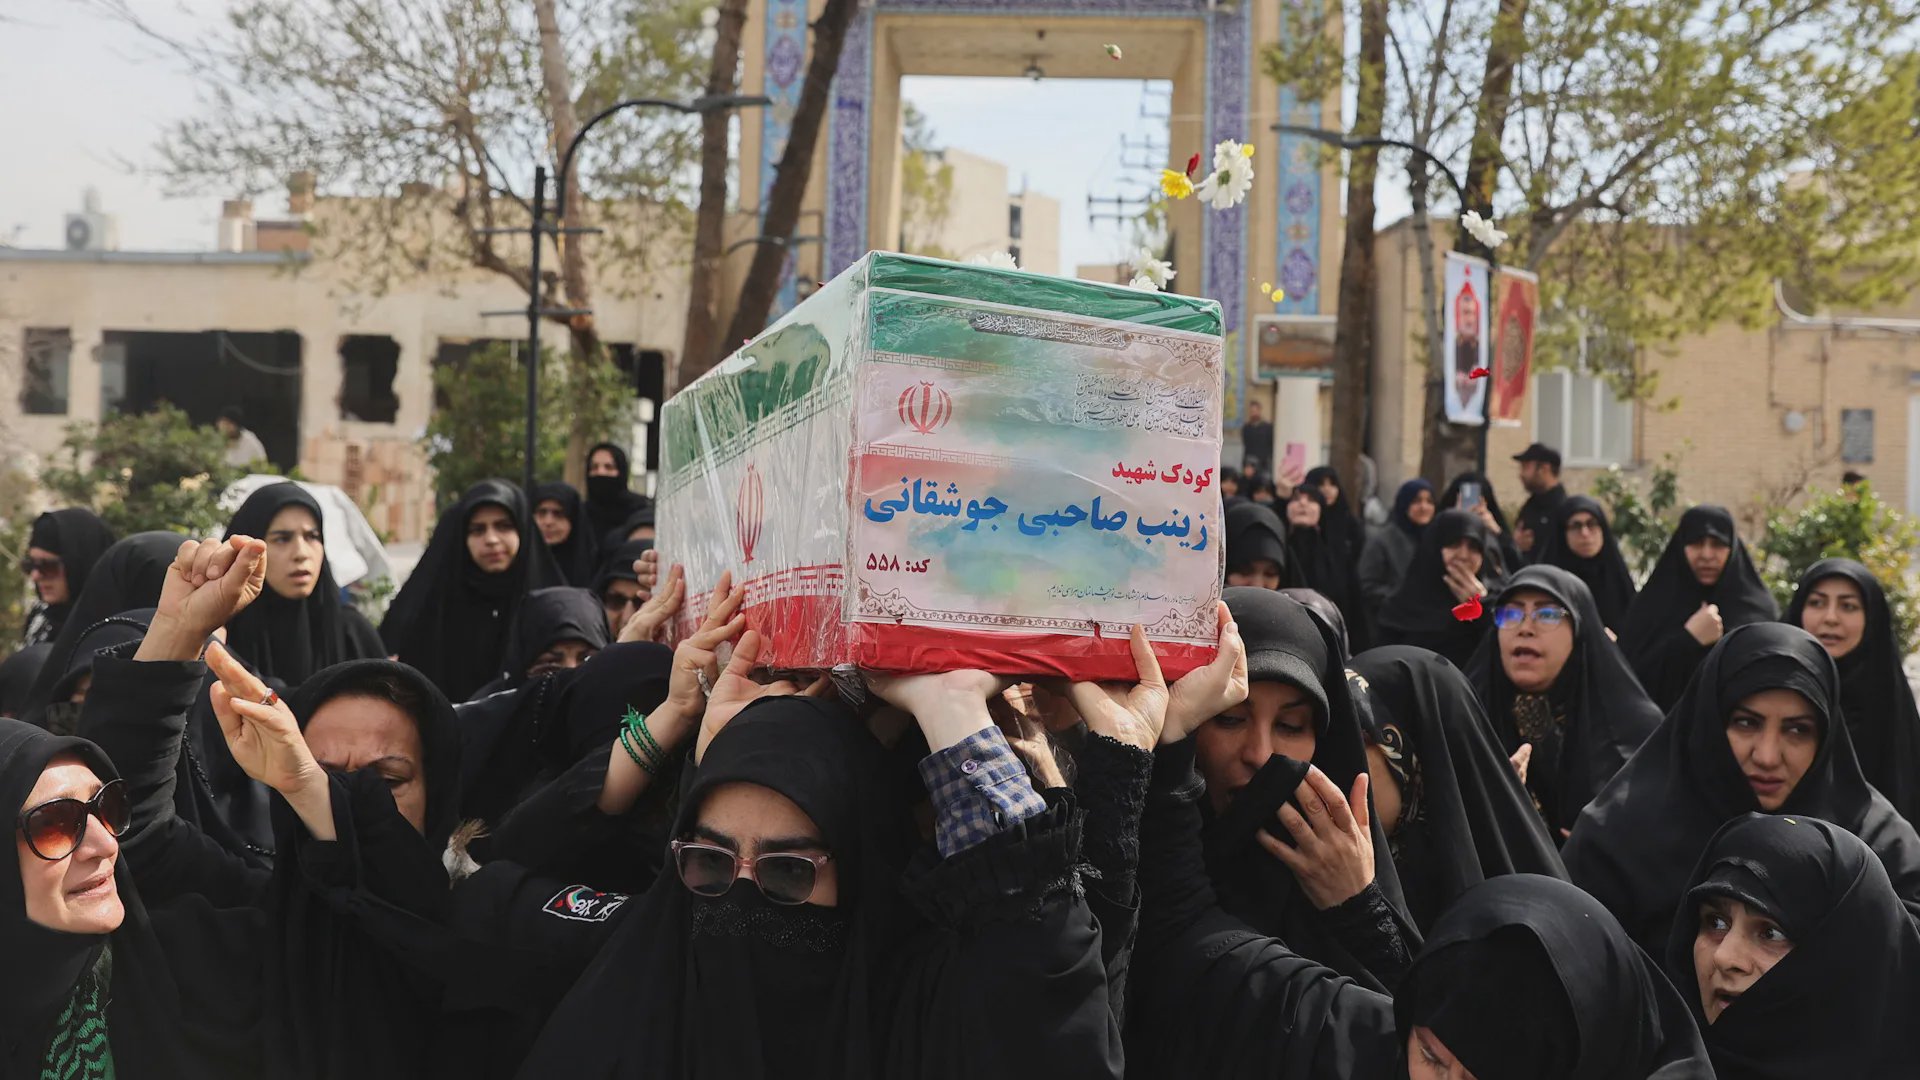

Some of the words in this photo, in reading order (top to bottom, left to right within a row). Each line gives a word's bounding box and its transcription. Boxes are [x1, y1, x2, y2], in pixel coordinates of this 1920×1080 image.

[1111, 460, 1157, 485] شهید
[1161, 463, 1213, 493] کودک
[864, 476, 1009, 531] جوشقانی
[1017, 495, 1128, 537] صاحبی
[1136, 508, 1209, 551] زینب
[866, 553, 900, 572] ۵۵۸
[905, 558, 930, 574] کد:
